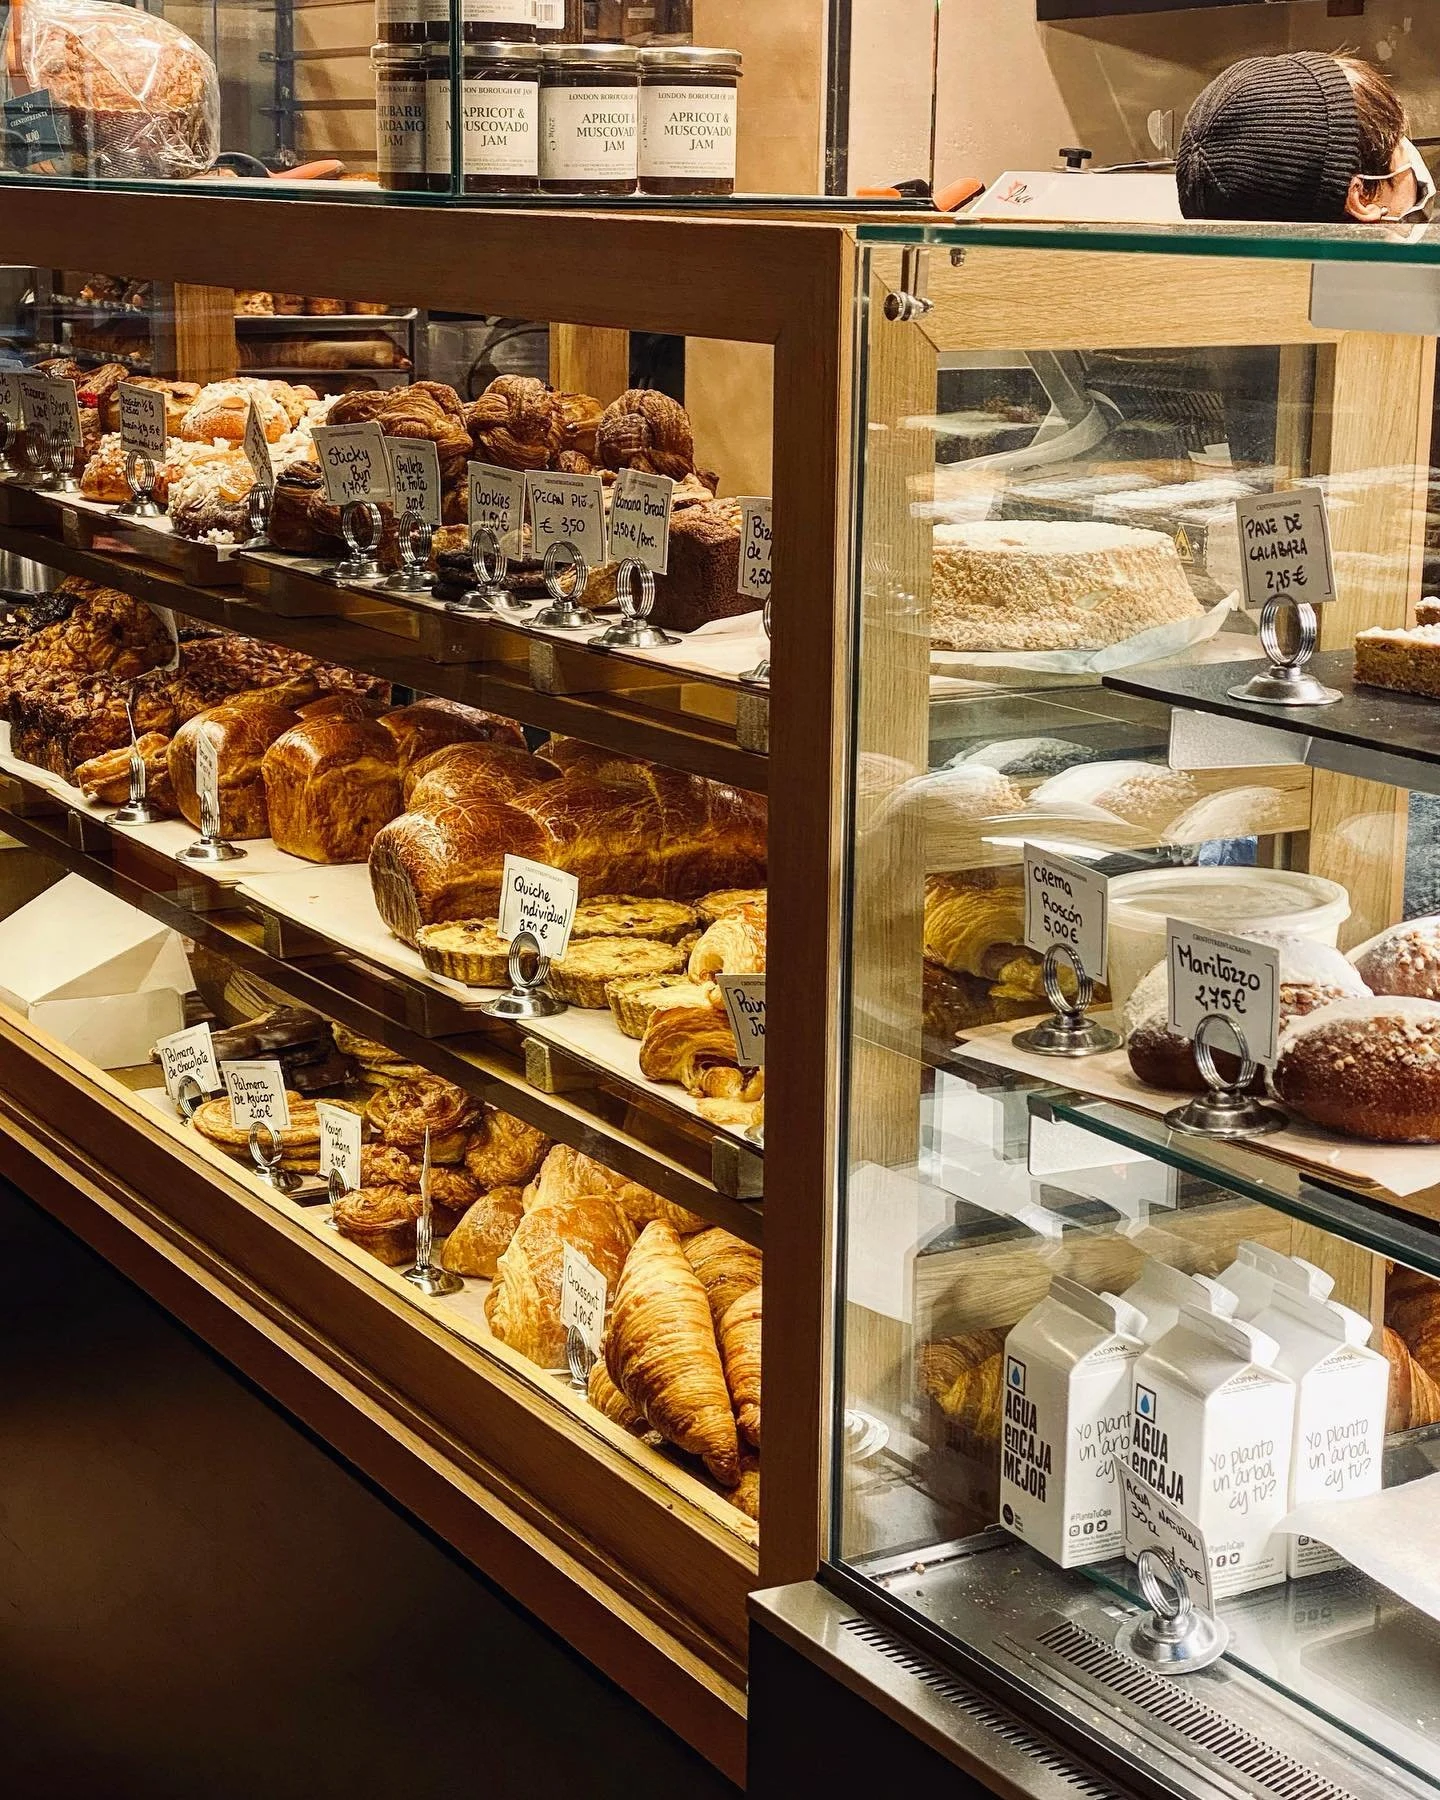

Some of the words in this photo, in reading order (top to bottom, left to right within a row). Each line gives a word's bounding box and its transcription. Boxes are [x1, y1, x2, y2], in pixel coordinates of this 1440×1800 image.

[479, 87, 512, 95] BOROUGH
[517, 108, 525, 118] &
[581, 113, 630, 124] APRICOT
[669, 111, 721, 123] APRICOT
[723, 113, 730, 123] &
[383, 134, 403, 147] JAM
[480, 134, 507, 147] JAM
[664, 125, 732, 137] MUSCOVADO
[602, 140, 625, 152] JAM
[689, 138, 714, 151] JAM
[328, 446, 371, 468] Sticky
[350, 464, 371, 482] Bun
[396, 475, 407, 492] de
[475, 481, 511, 510] Cookies
[533, 489, 564, 506] PECAN
[615, 487, 642, 512] Banana
[643, 493, 666, 518] Bread
[539, 517, 555, 534] €
[561, 517, 586, 536] 3,50
[1283, 513, 1303, 534] DE
[747, 541, 761, 560] de
[1249, 538, 1308, 561] CALABAZA
[514, 876, 551, 903] Quiche
[520, 898, 568, 928] Individual
[1041, 891, 1083, 928] Roscón
[1044, 914, 1079, 944] 5,00€
[1177, 944, 1261, 991] Maritozzo
[1195, 984, 1247, 1014] 2,75€
[165, 1046, 195, 1063] Palmera
[168, 1066, 178, 1079] de
[231, 1072, 269, 1091] Palmera
[234, 1091, 246, 1105] de
[1005, 1389, 1038, 1434] AGUA
[1133, 1418, 1168, 1463] AGUA
[1305, 1431, 1322, 1450] Yo
[1326, 1418, 1369, 1452] planto
[1004, 1422, 1052, 1475] enCAJA
[1079, 1443, 1097, 1461] un
[1209, 1453, 1226, 1472] Yo
[1231, 1439, 1274, 1474] planto
[1309, 1452, 1326, 1470] un
[1003, 1449, 1047, 1503] MEJOR
[1131, 1451, 1184, 1505] enCAJA
[1213, 1474, 1230, 1493] un
[1126, 1478, 1152, 1510] AGUA
[1158, 1509, 1200, 1551] NATURAL
